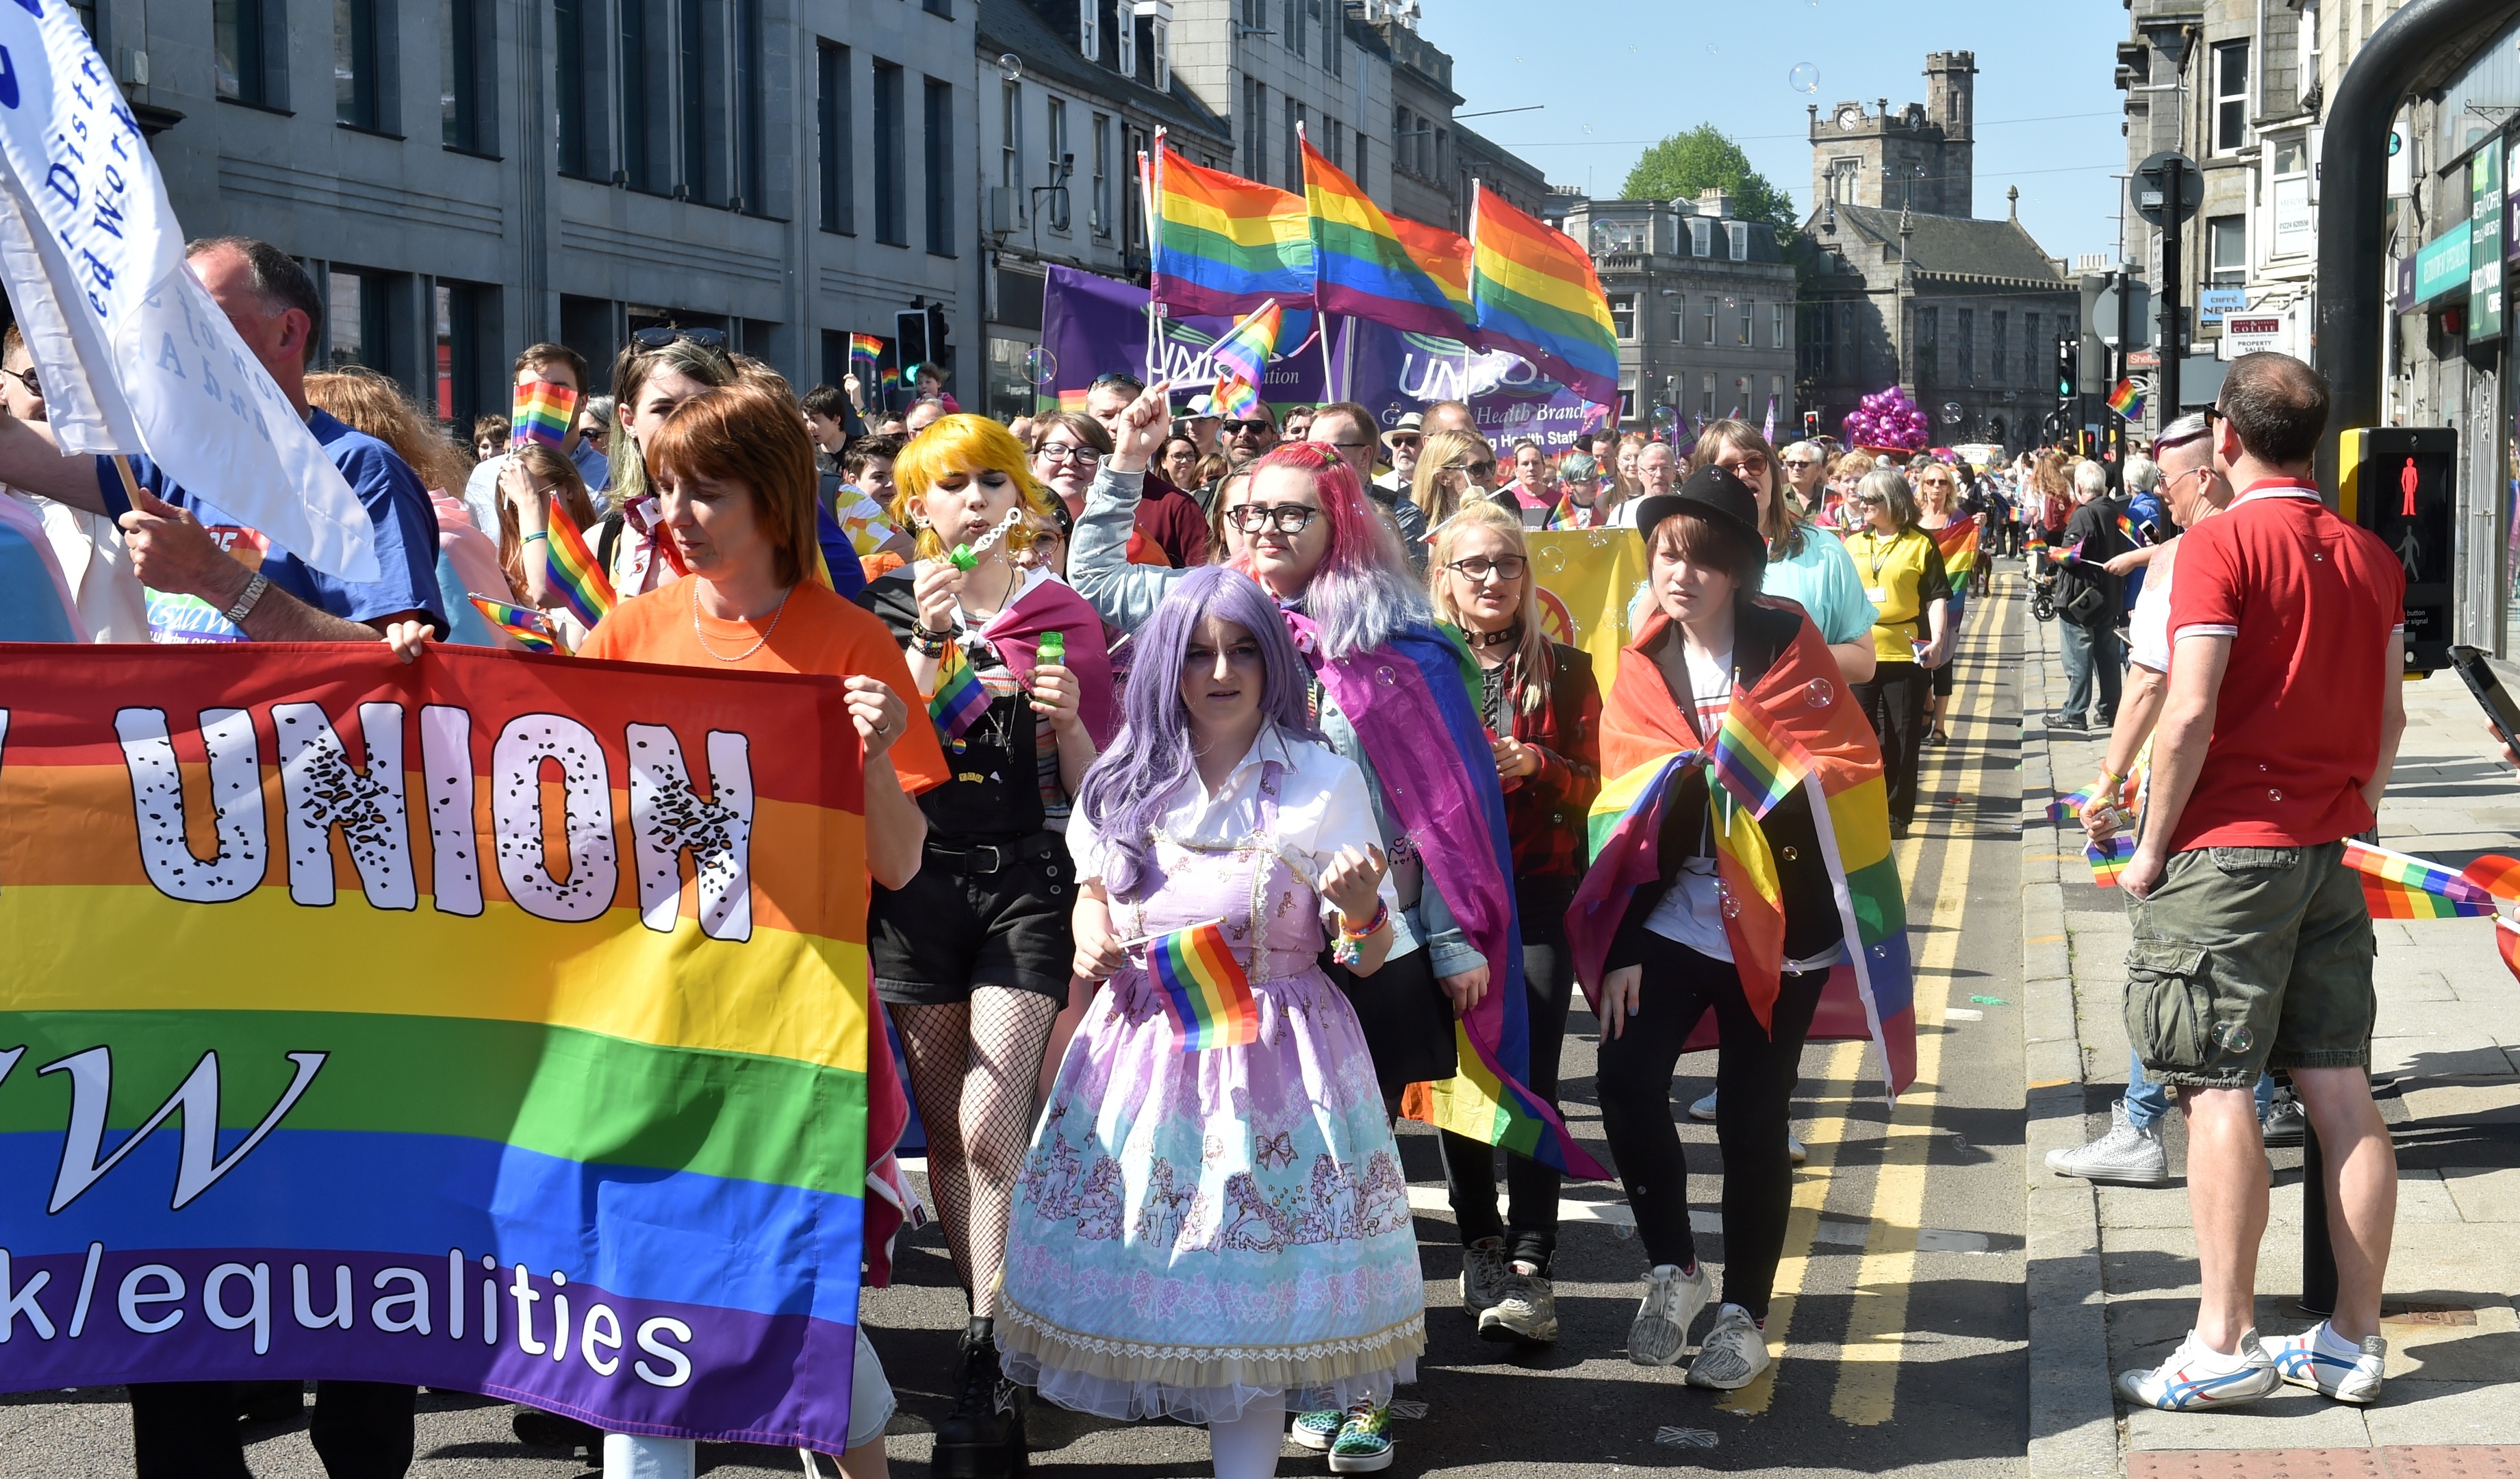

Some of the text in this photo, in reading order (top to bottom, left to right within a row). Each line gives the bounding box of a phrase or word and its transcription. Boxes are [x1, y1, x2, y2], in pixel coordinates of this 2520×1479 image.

[1476, 402, 1531, 425] Health
[1548, 430, 1578, 445] Staff
[2410, 618, 2428, 626] signal
[959, 772, 983, 782] YOU
[114, 701, 756, 943] UNION
